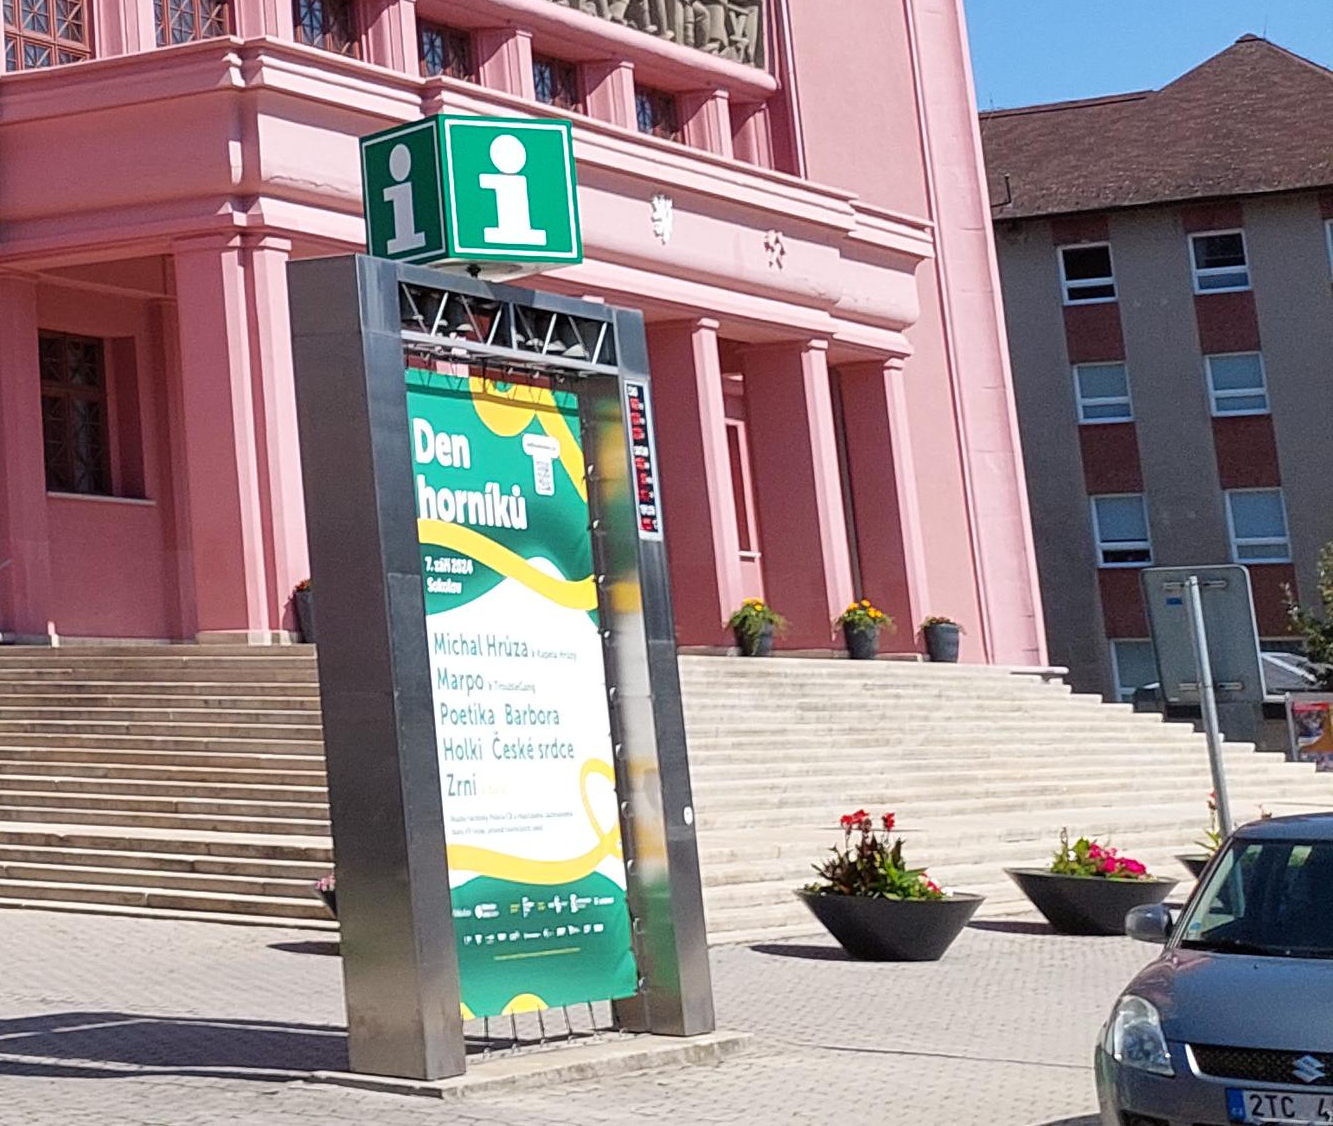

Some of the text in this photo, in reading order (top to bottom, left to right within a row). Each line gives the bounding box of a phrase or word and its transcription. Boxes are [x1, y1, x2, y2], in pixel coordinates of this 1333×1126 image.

[479, 134, 547, 246] i
[412, 417, 471, 469] Den
[417, 473, 528, 530] horníků
[427, 576, 462, 594] Sokolov
[433, 632, 483, 657] Michal
[486, 634, 529, 658] Hrůza
[437, 667, 484, 696] Marpo
[440, 702, 560, 726] Poetika Barbora
[443, 730, 575, 761] Holki České srdce
[1249, 1094, 1295, 1118] 2TC
[1317, 1097, 1333, 1121] 4
